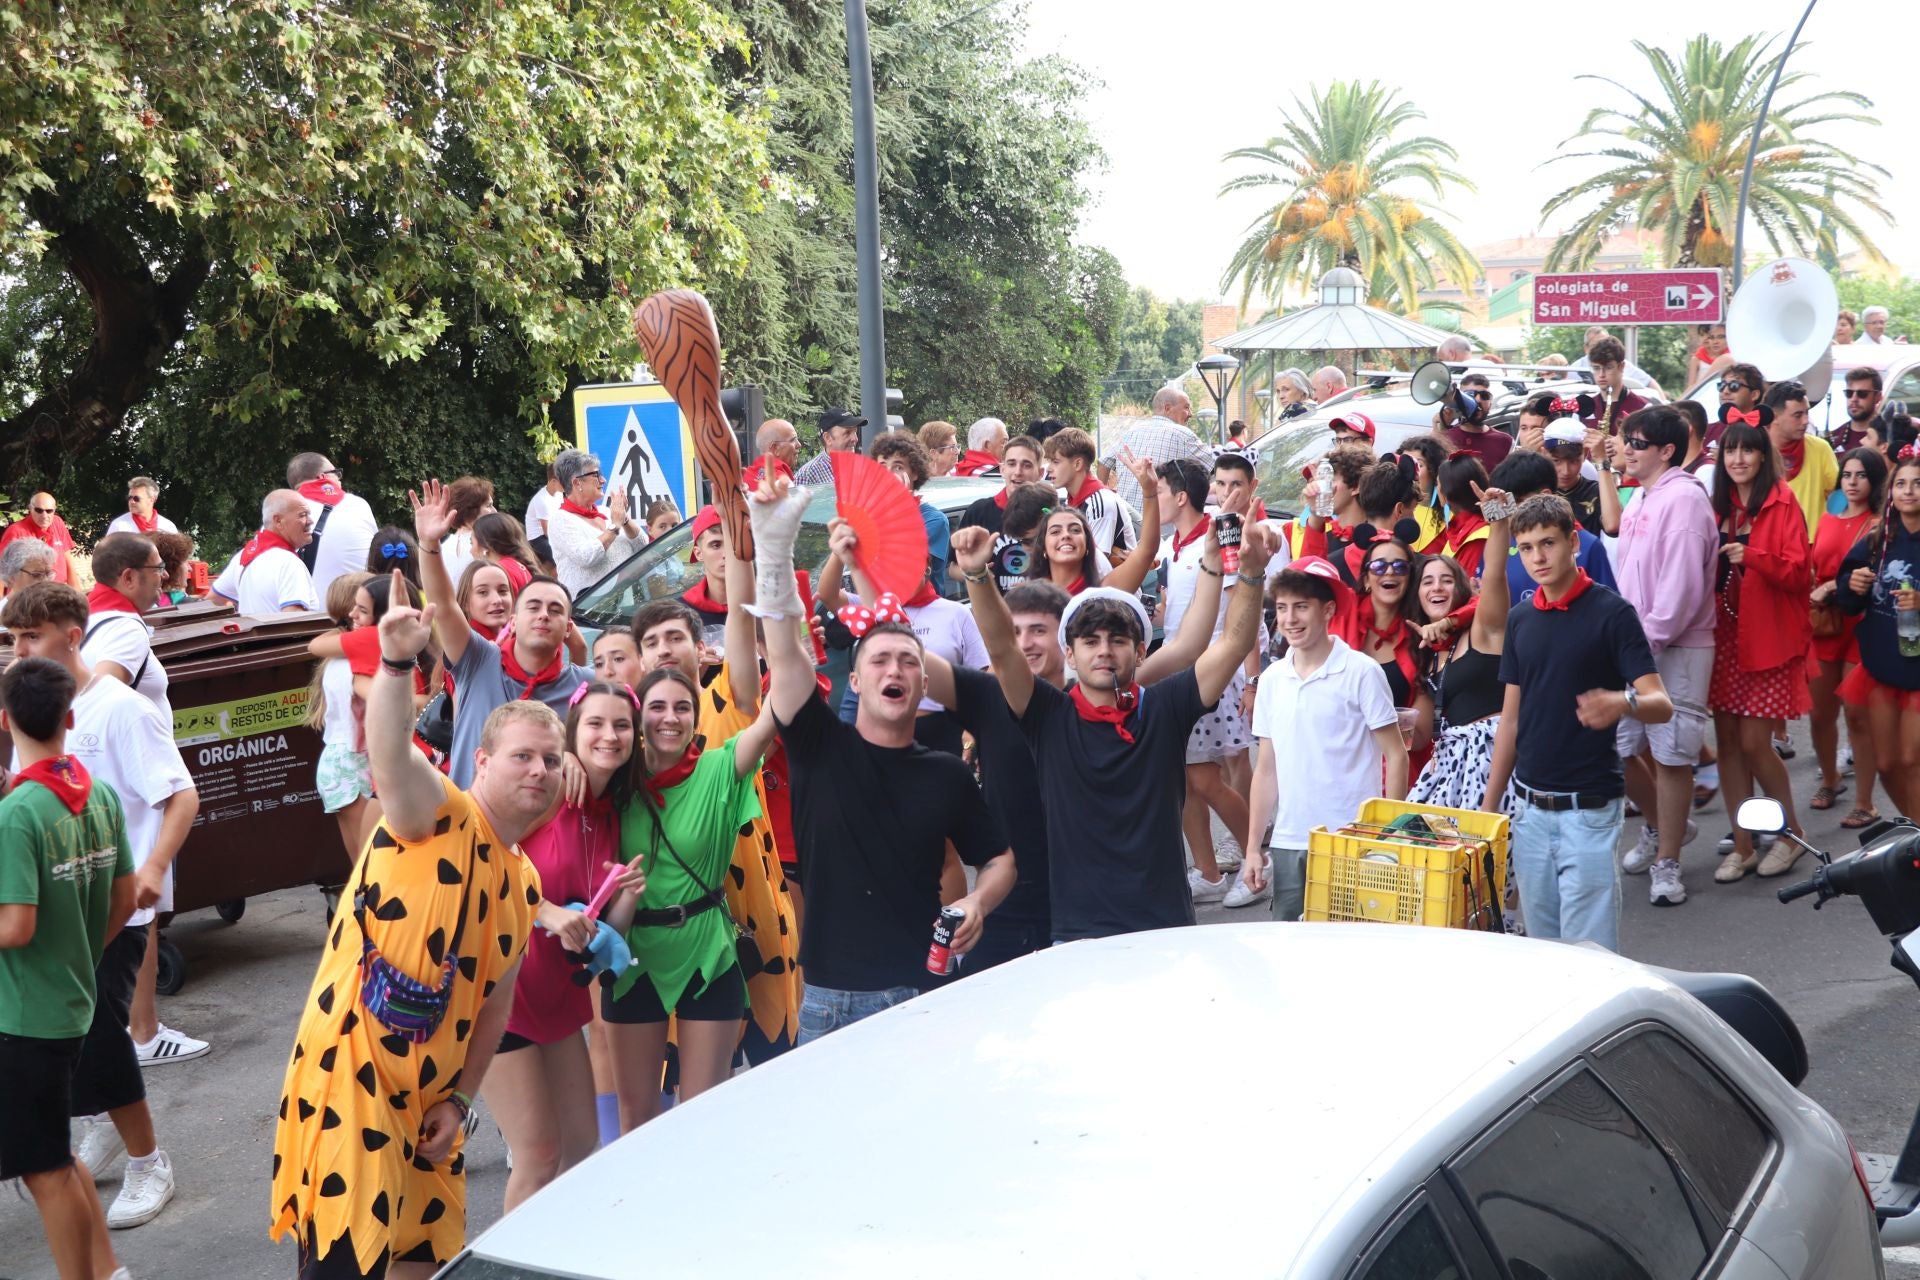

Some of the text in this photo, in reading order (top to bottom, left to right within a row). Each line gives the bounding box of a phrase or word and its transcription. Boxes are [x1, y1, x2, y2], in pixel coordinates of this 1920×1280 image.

[1538, 281, 1629, 295] colegiata de
[1538, 300, 1636, 319] San Miguel
[236, 688, 310, 715] DEPOSITA AQUÍ
[232, 711, 273, 728] RESTOS
[275, 709, 290, 720] DE
[198, 734, 289, 767] ORGÁNICA
